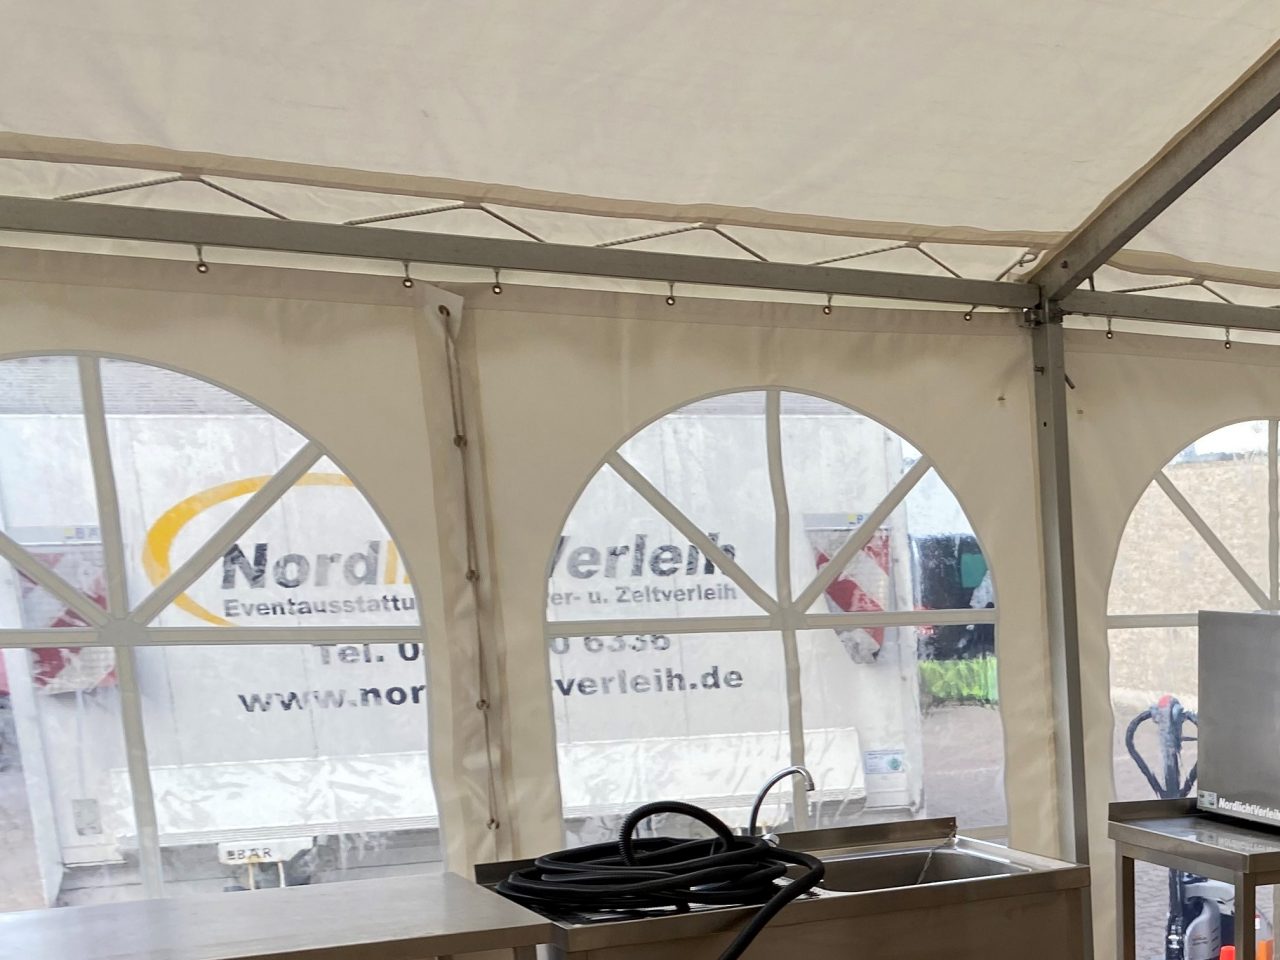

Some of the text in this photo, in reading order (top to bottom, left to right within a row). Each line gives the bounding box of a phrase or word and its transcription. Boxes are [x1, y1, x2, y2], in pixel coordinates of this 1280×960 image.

[615, 583, 737, 604] Zeltverleih
[313, 643, 384, 665] Tel.
[555, 666, 743, 696] verleih.de
[1218, 797, 1280, 821] NordlichtVerleih
